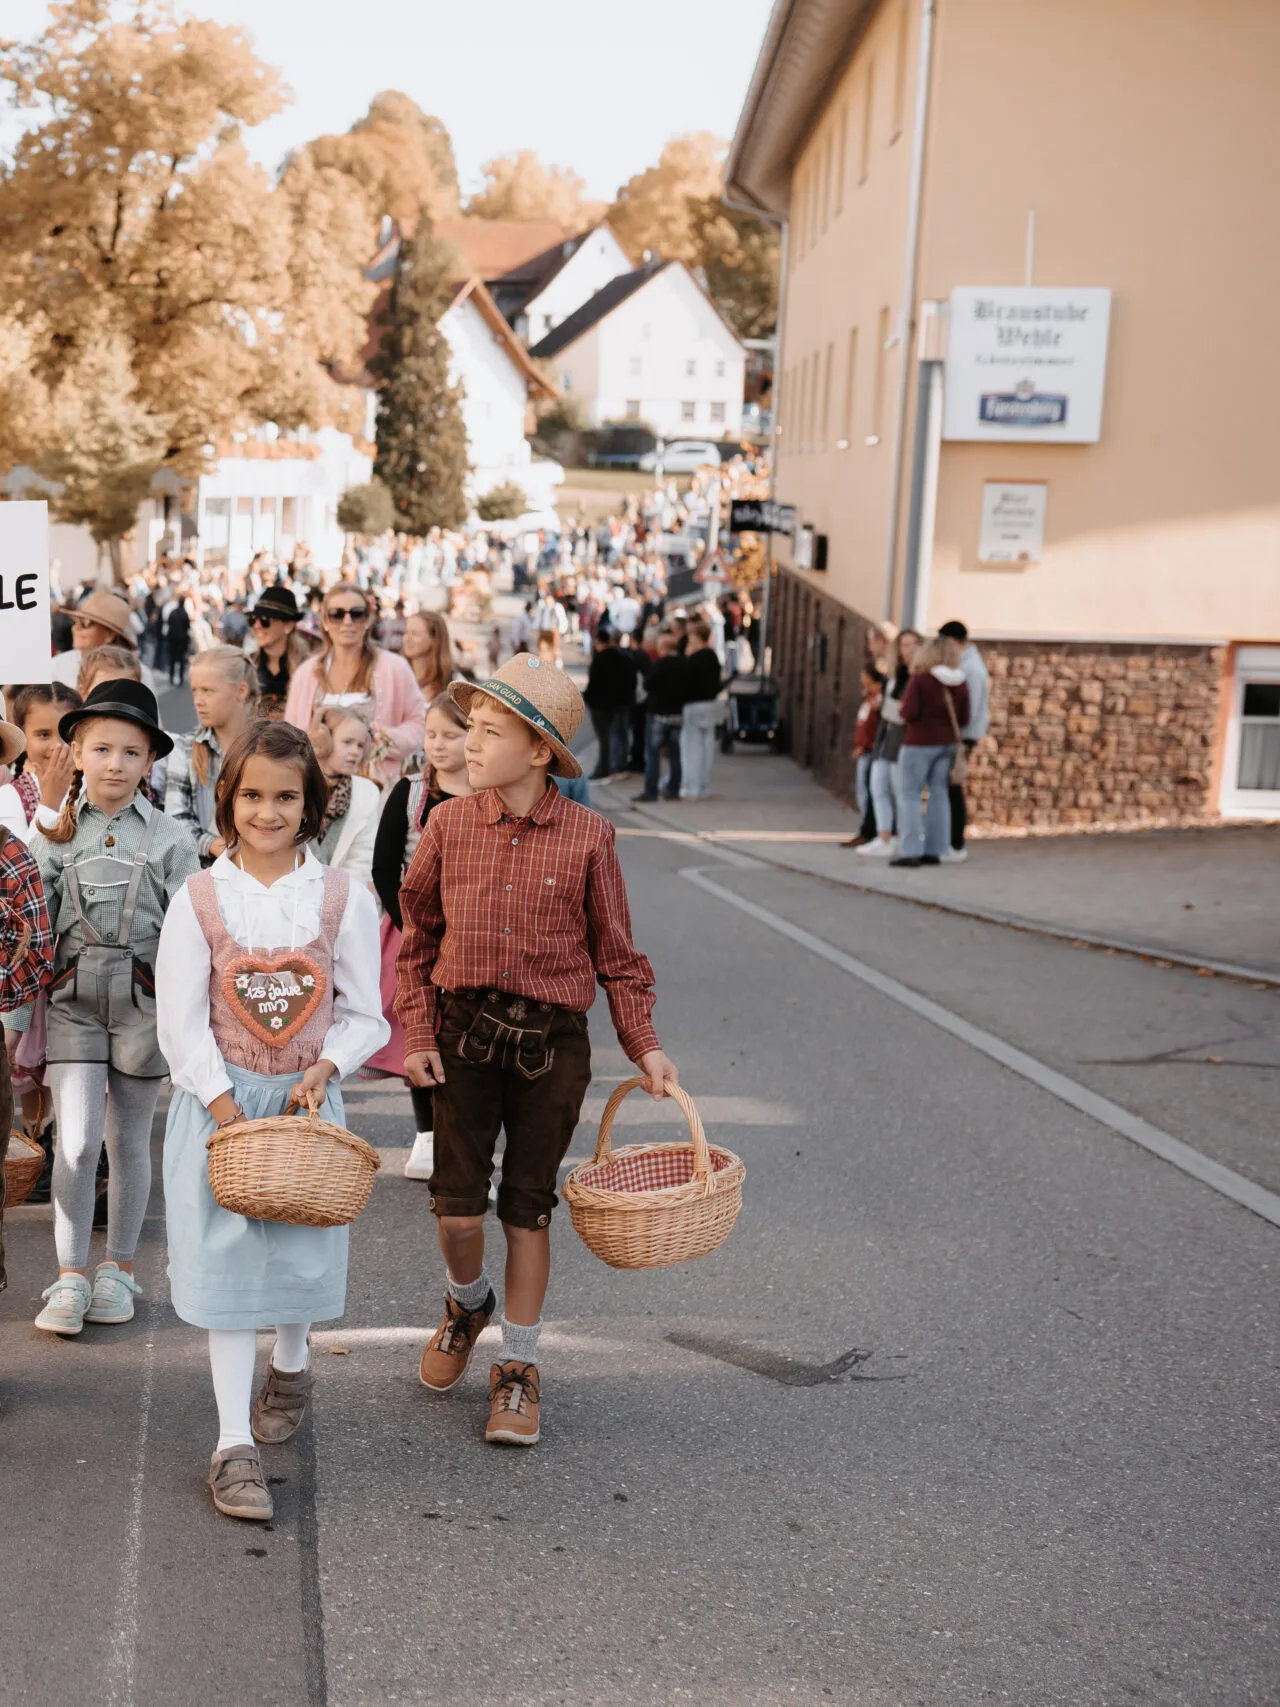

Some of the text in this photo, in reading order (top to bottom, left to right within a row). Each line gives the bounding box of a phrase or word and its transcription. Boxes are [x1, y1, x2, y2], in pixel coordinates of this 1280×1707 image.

[500, 687, 522, 705] GUAD
[245, 981, 304, 1000] 125 Jahre
